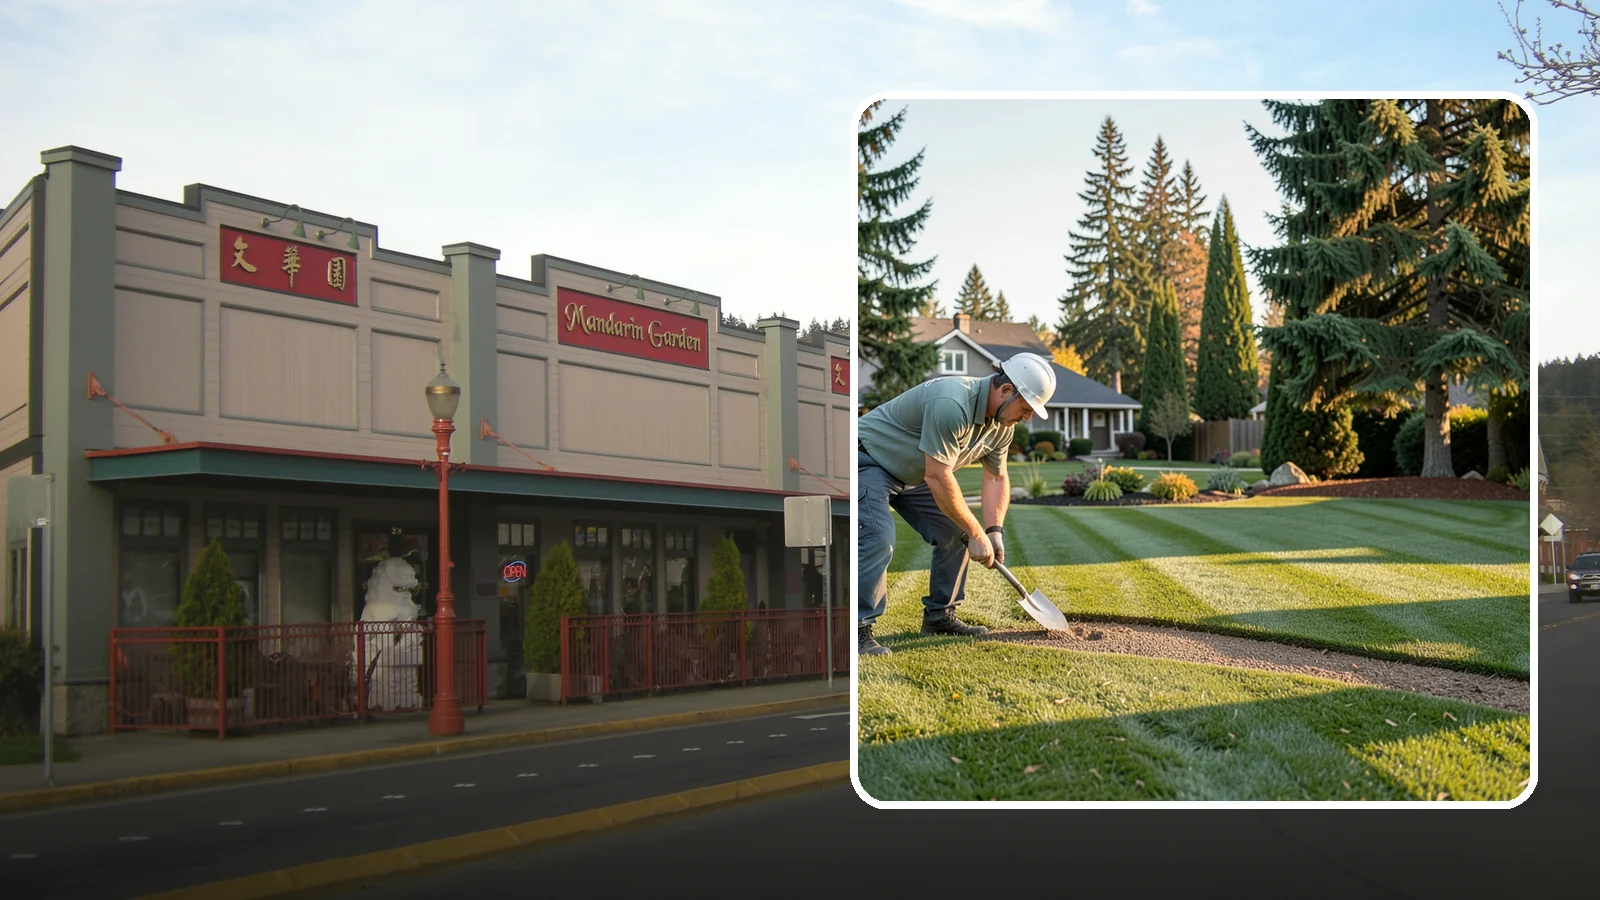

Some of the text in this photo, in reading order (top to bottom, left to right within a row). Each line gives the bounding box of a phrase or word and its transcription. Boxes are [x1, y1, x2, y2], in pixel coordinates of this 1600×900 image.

[231, 236, 346, 291] 文華園
[564, 302, 701, 352] Mandarin Garden
[503, 565, 527, 578] OPEN
